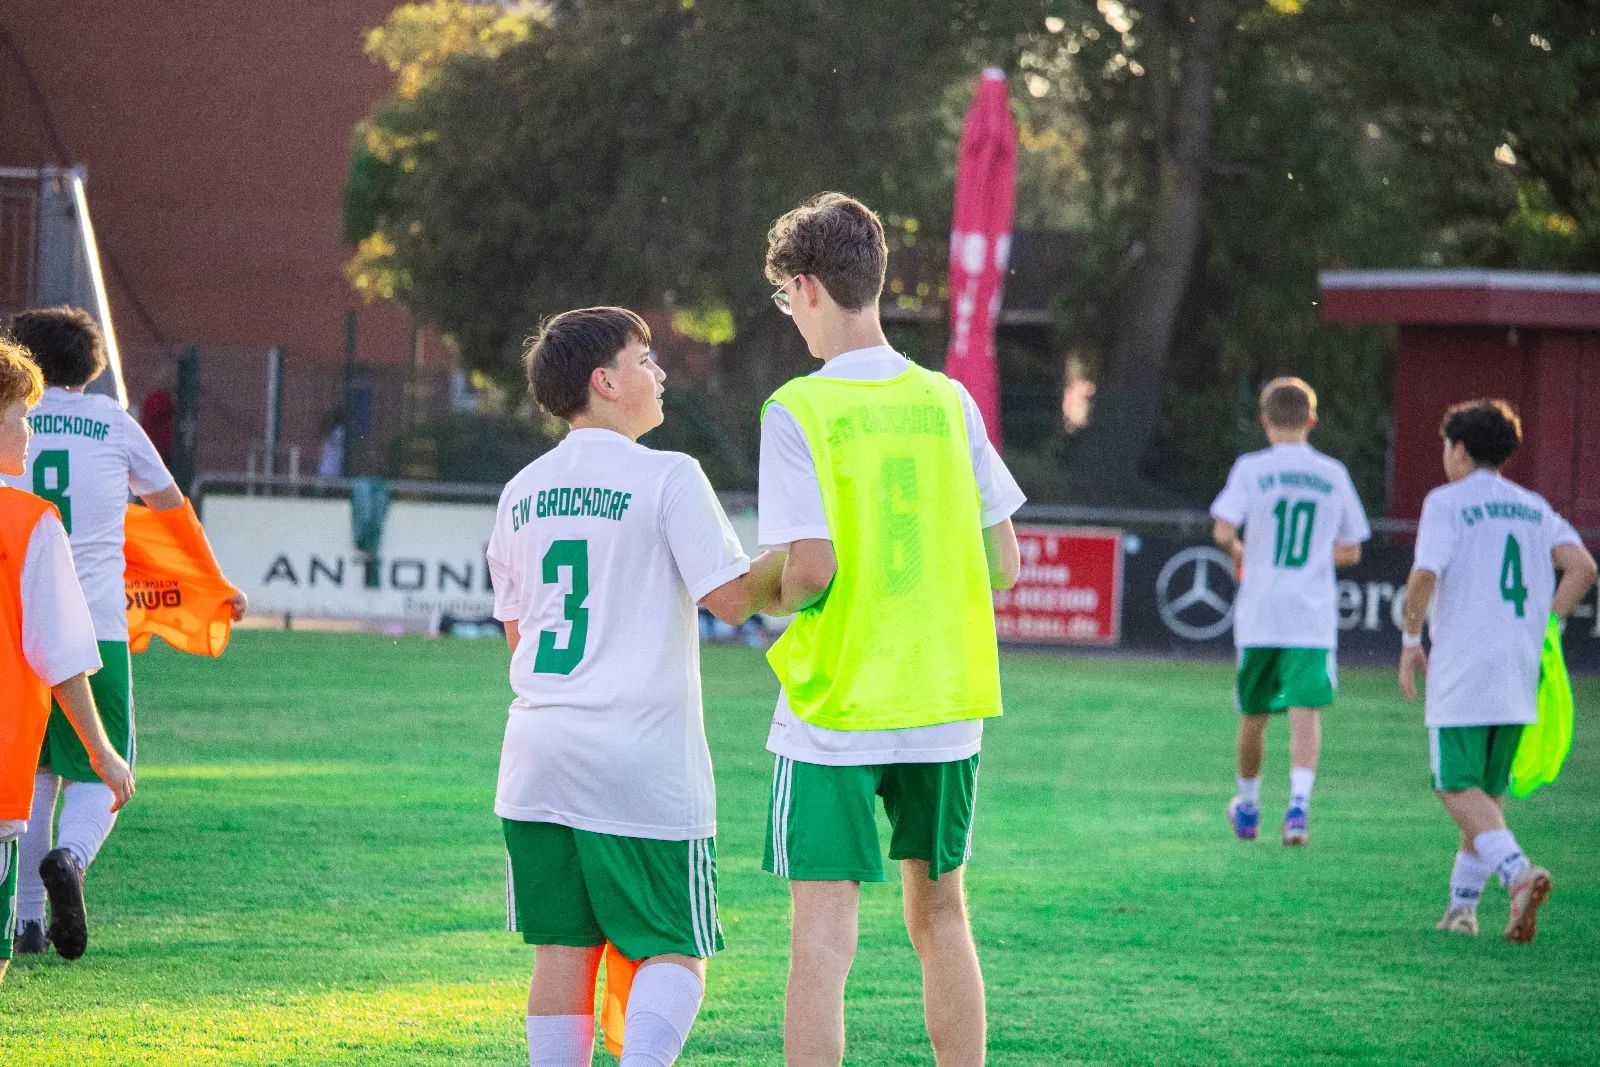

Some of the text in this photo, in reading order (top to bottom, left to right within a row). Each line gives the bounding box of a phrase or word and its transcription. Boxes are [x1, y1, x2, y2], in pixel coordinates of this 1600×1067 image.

[512, 487, 632, 533] GW BROCKDORF
[881, 456, 924, 597] 6
[1272, 496, 1317, 571] 10
[533, 539, 589, 676] 3
[1499, 532, 1528, 618] 4
